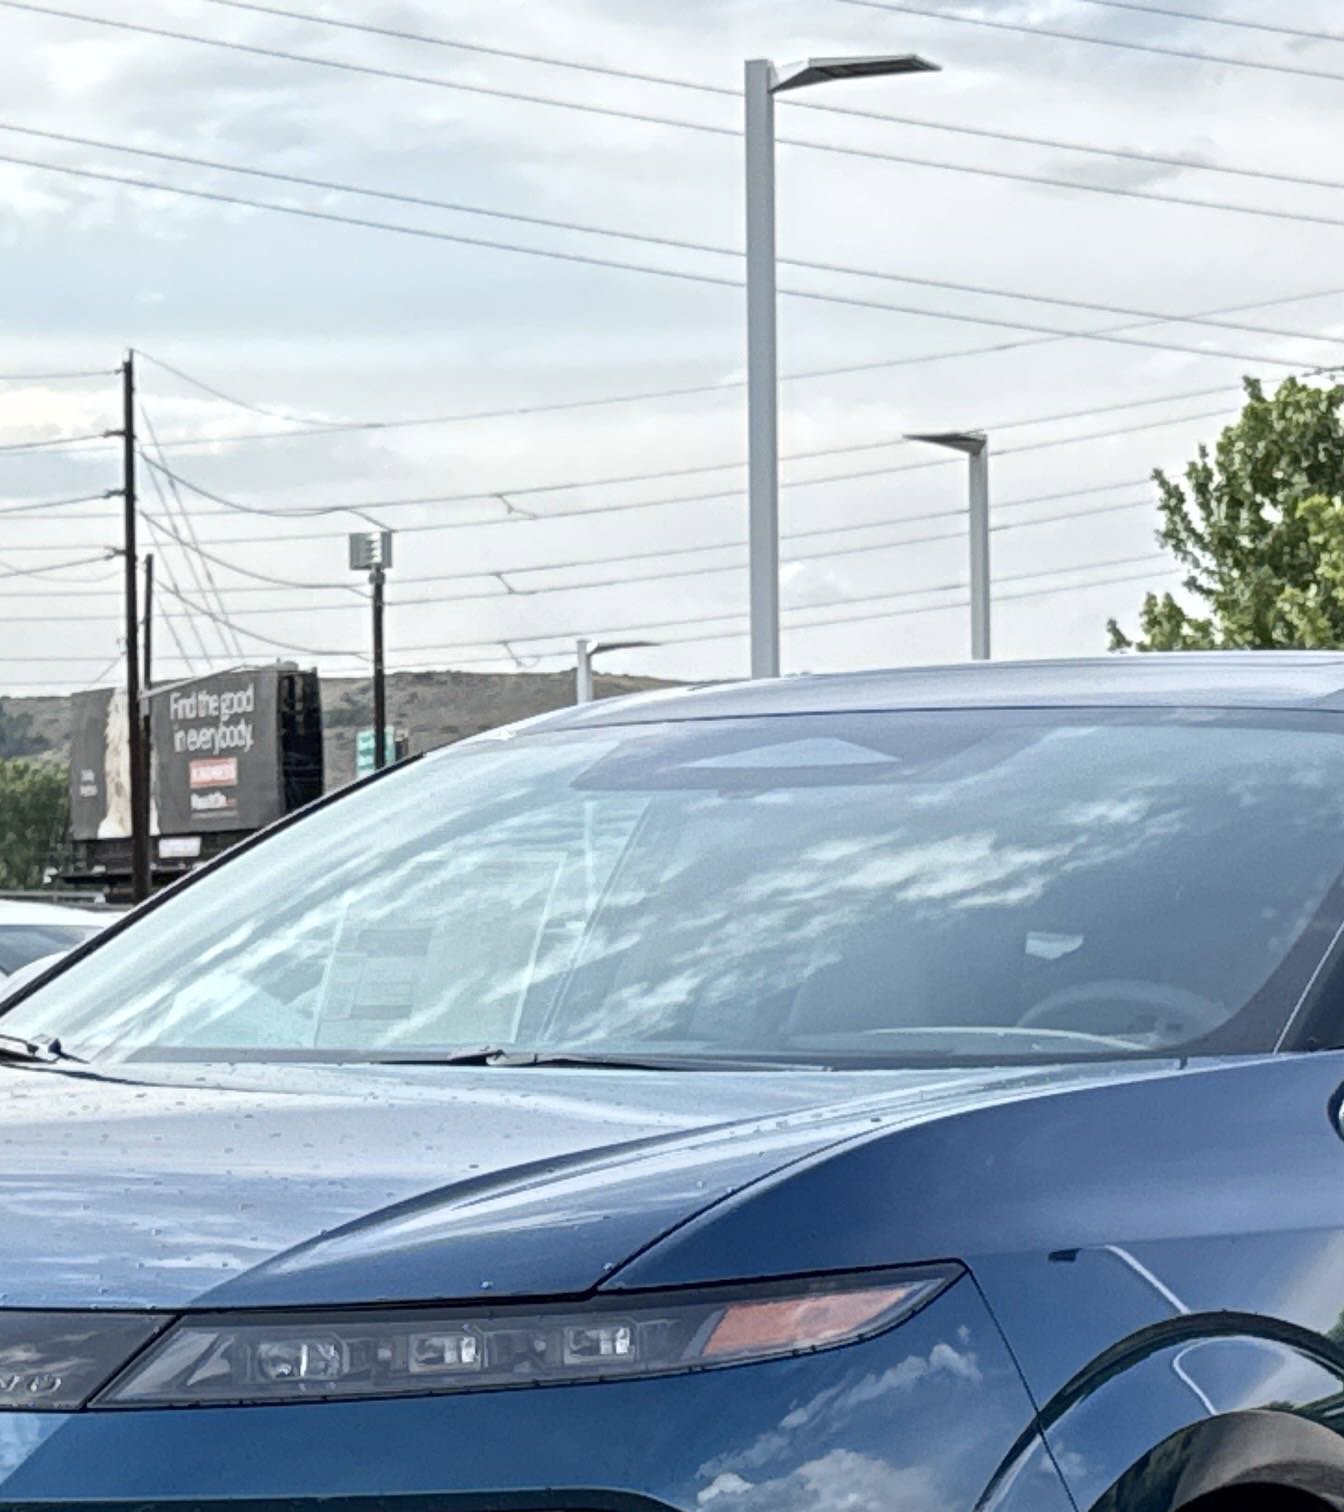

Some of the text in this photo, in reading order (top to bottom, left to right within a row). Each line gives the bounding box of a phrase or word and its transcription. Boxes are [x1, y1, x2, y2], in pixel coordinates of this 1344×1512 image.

[169, 682, 254, 722] Find the good
[173, 718, 255, 755] in everybody.
